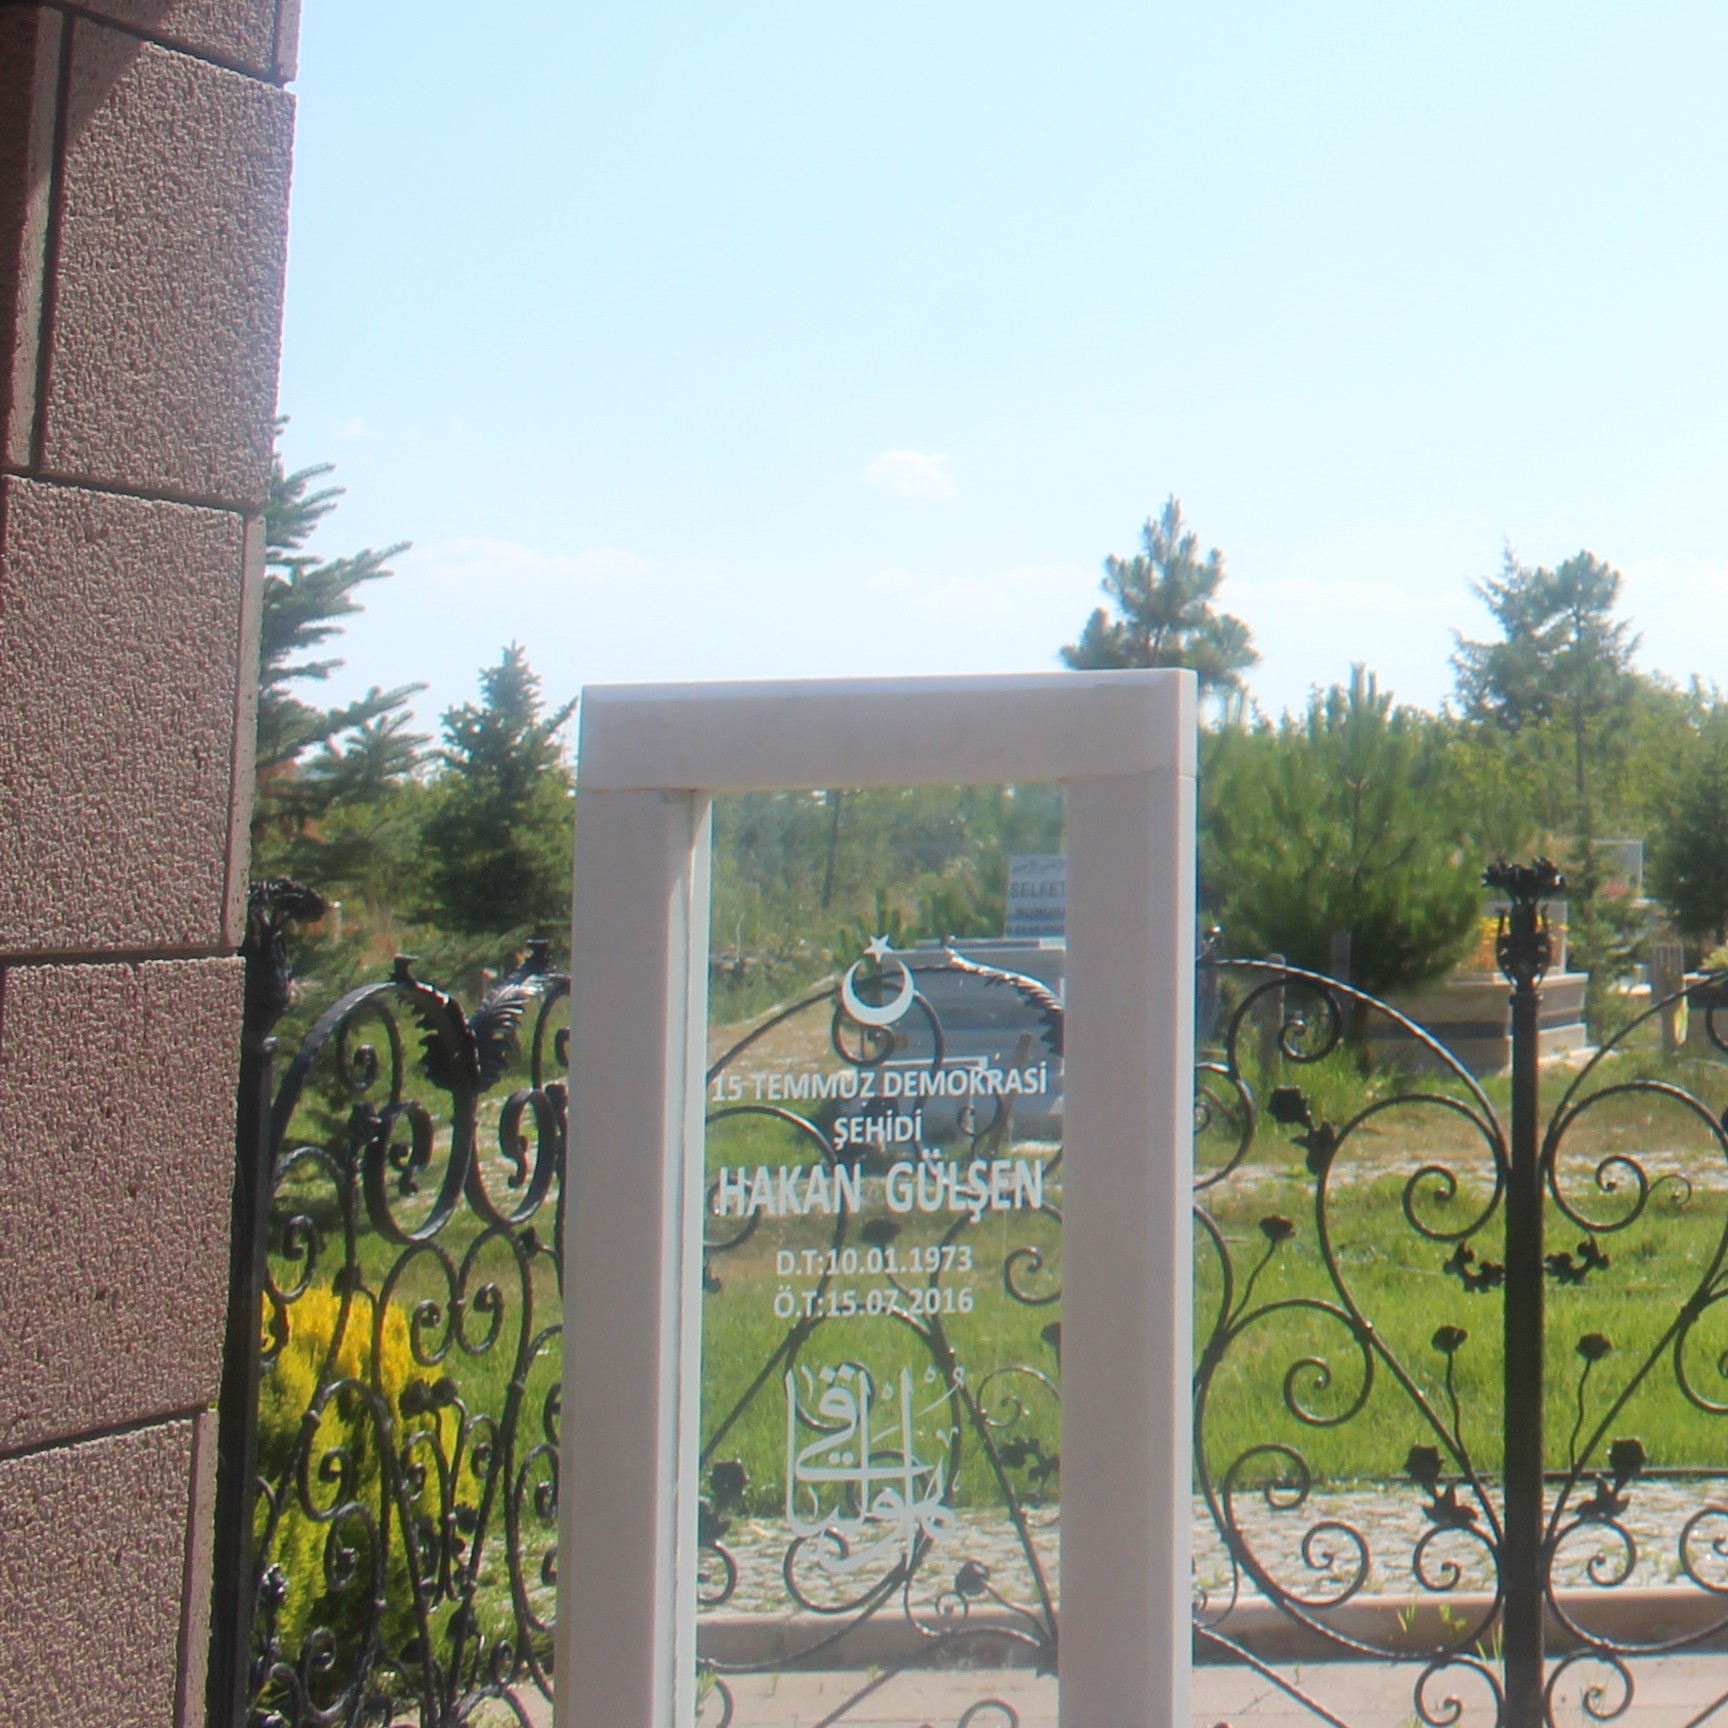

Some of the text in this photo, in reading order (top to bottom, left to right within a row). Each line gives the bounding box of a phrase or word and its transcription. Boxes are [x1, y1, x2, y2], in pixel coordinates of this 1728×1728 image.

[711, 1061, 1047, 1102] 15 TEMMUZ DEMOKRASİ
[833, 1109, 923, 1150] ŞEHİDİ
[718, 1148, 1043, 1222] HAKAN GÜLŞEN
[776, 1245, 973, 1276] D.T:10.01.1973
[773, 1285, 974, 1318] Ö.T:15.07.2016
